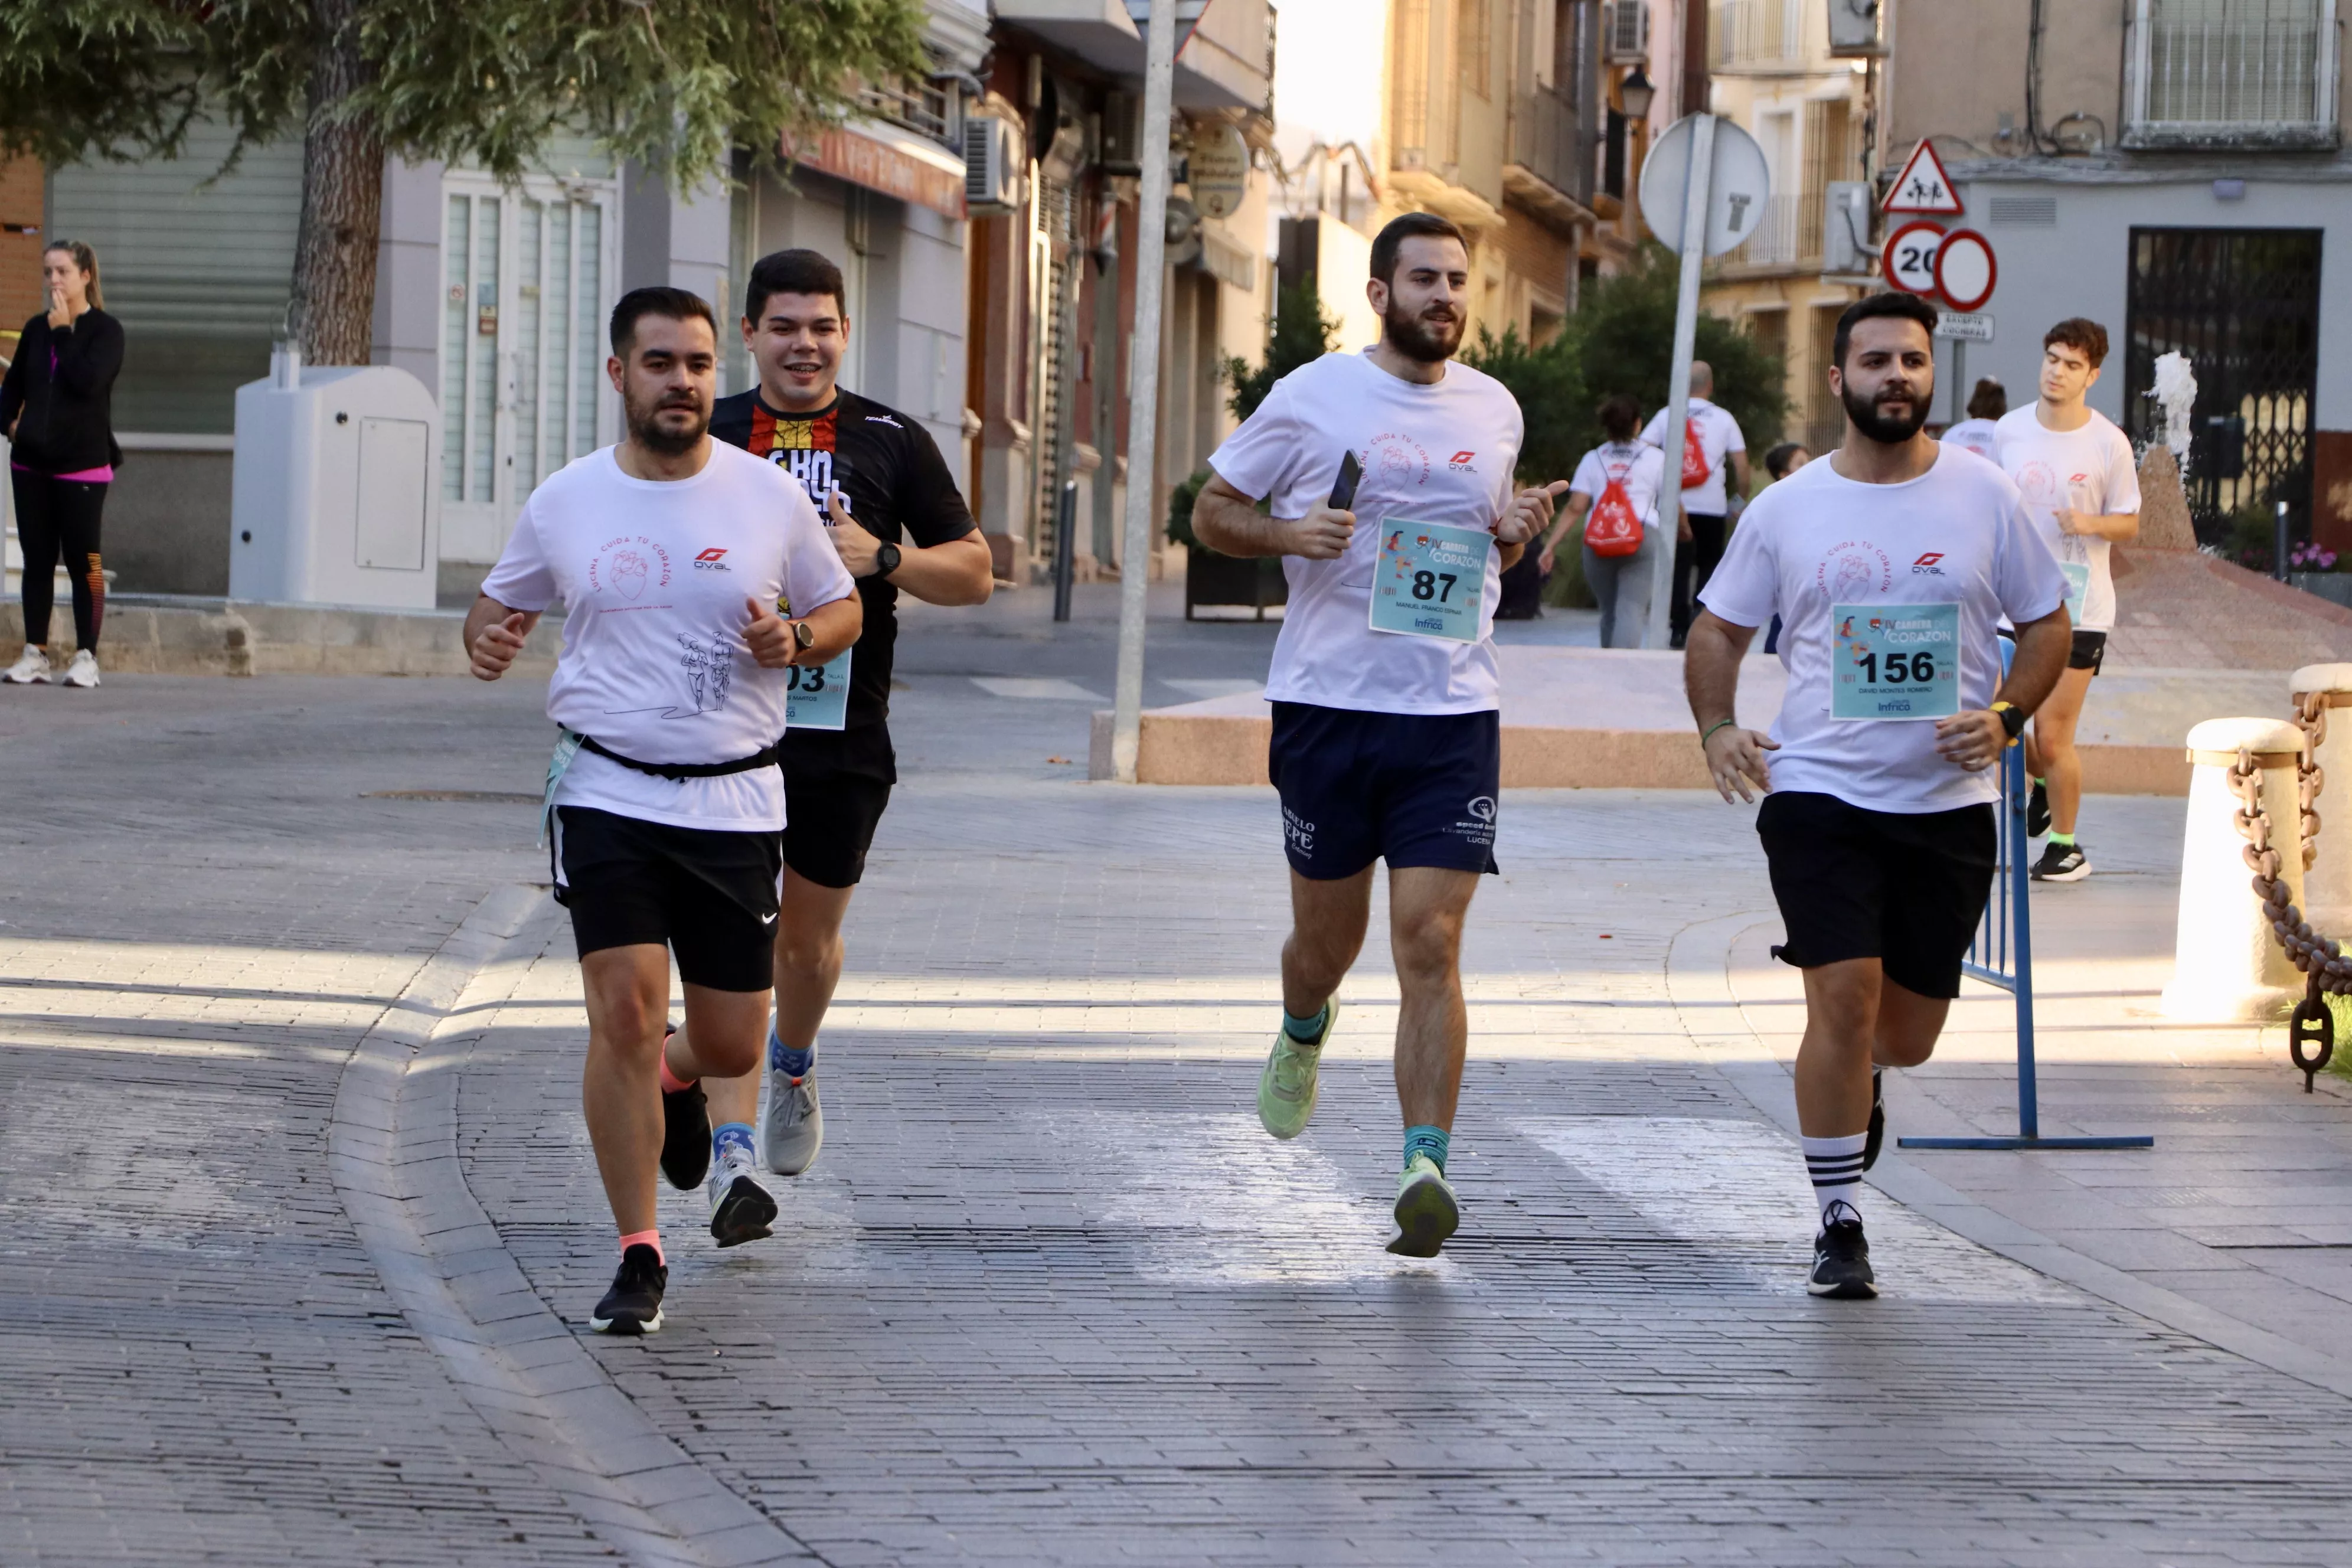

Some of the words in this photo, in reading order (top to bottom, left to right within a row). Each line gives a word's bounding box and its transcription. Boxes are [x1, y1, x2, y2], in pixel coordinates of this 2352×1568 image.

[1946, 313, 1984, 325] EXCEPTO
[1370, 433, 1396, 445] CUIDA
[1402, 435, 1412, 443] TU
[1440, 541, 1469, 554] CARRERA
[1828, 541, 1856, 556] CUIDA
[1862, 541, 1873, 549] TU
[601, 537, 630, 551] CUIDA
[637, 536, 649, 544] TU
[652, 544, 671, 587] CORAZÓN
[1412, 570, 1457, 603] 87
[1396, 600, 1420, 609] MANUEL
[1421, 604, 1443, 612] FRANCO
[1895, 619, 1932, 630] CARRERA
[1860, 651, 1935, 683] 156
[1283, 805, 1315, 832] ABUELO
[1466, 836, 1491, 845] LUCENA
